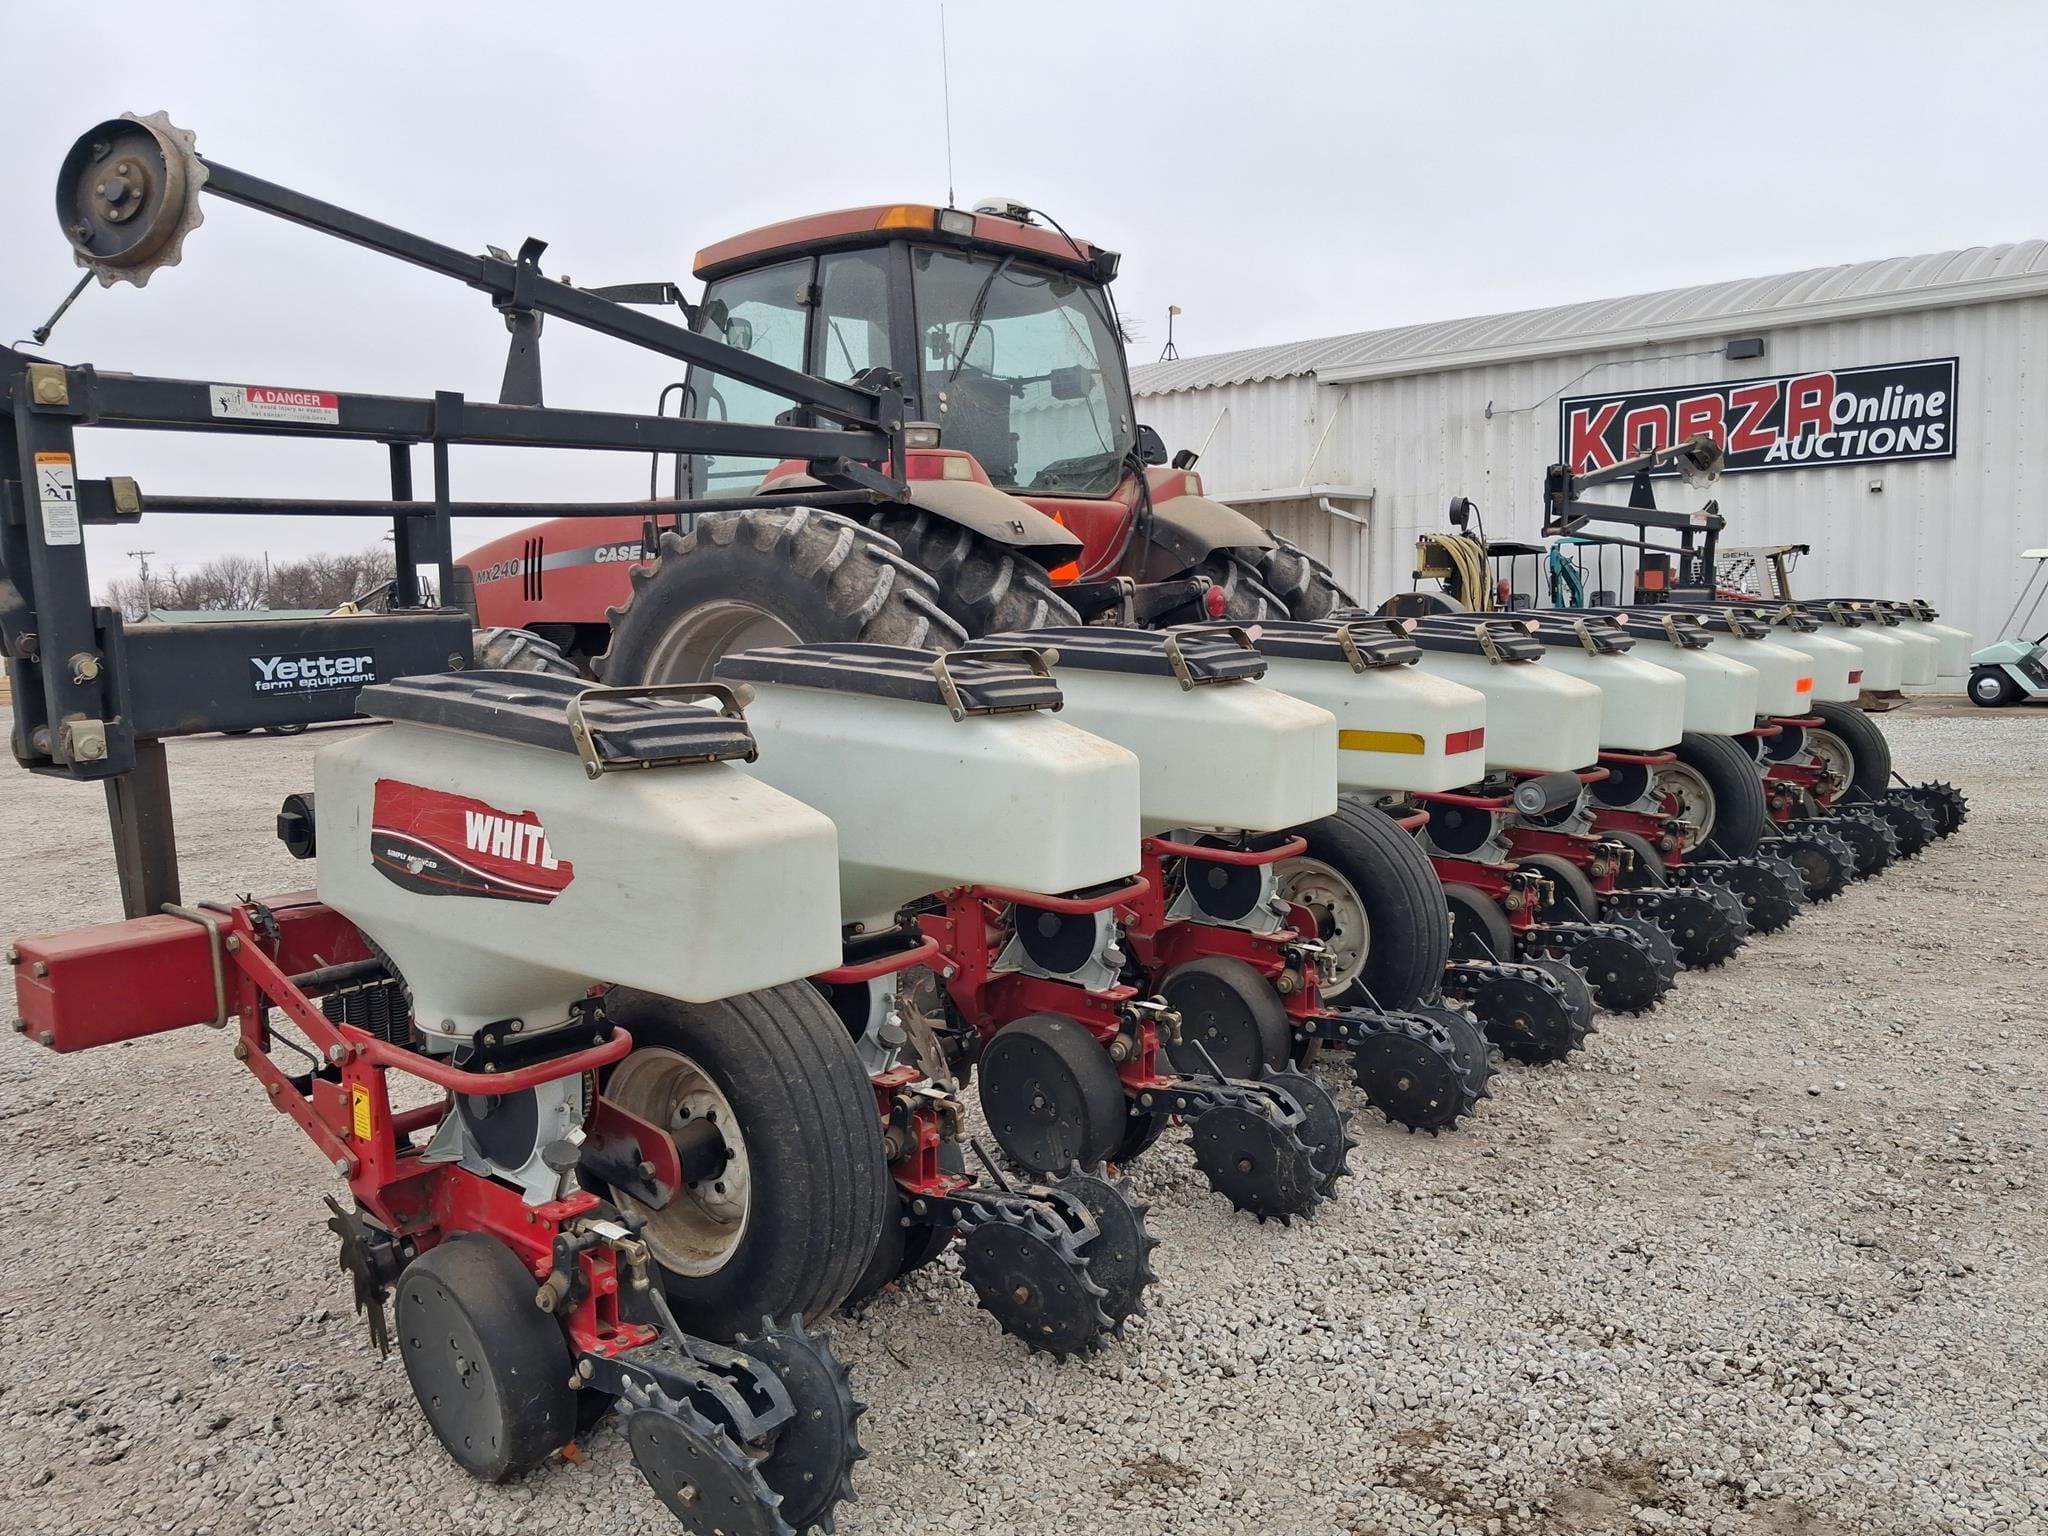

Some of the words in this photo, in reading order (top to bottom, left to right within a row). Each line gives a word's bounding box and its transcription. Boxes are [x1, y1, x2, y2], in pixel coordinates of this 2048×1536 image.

[266, 391, 321, 406] DANGER
[278, 405, 296, 413] injury
[1570, 371, 1836, 476] KOBZA
[1831, 385, 1945, 425] Online
[1764, 423, 1945, 462] AUCTIONS
[594, 545, 643, 563] CASE
[1722, 551, 1754, 559] GEHL
[476, 558, 520, 585] MX240
[250, 656, 373, 681] Yetter
[255, 681, 293, 691] farm
[299, 673, 376, 688] equipment
[387, 849, 408, 860] SIMPLY
